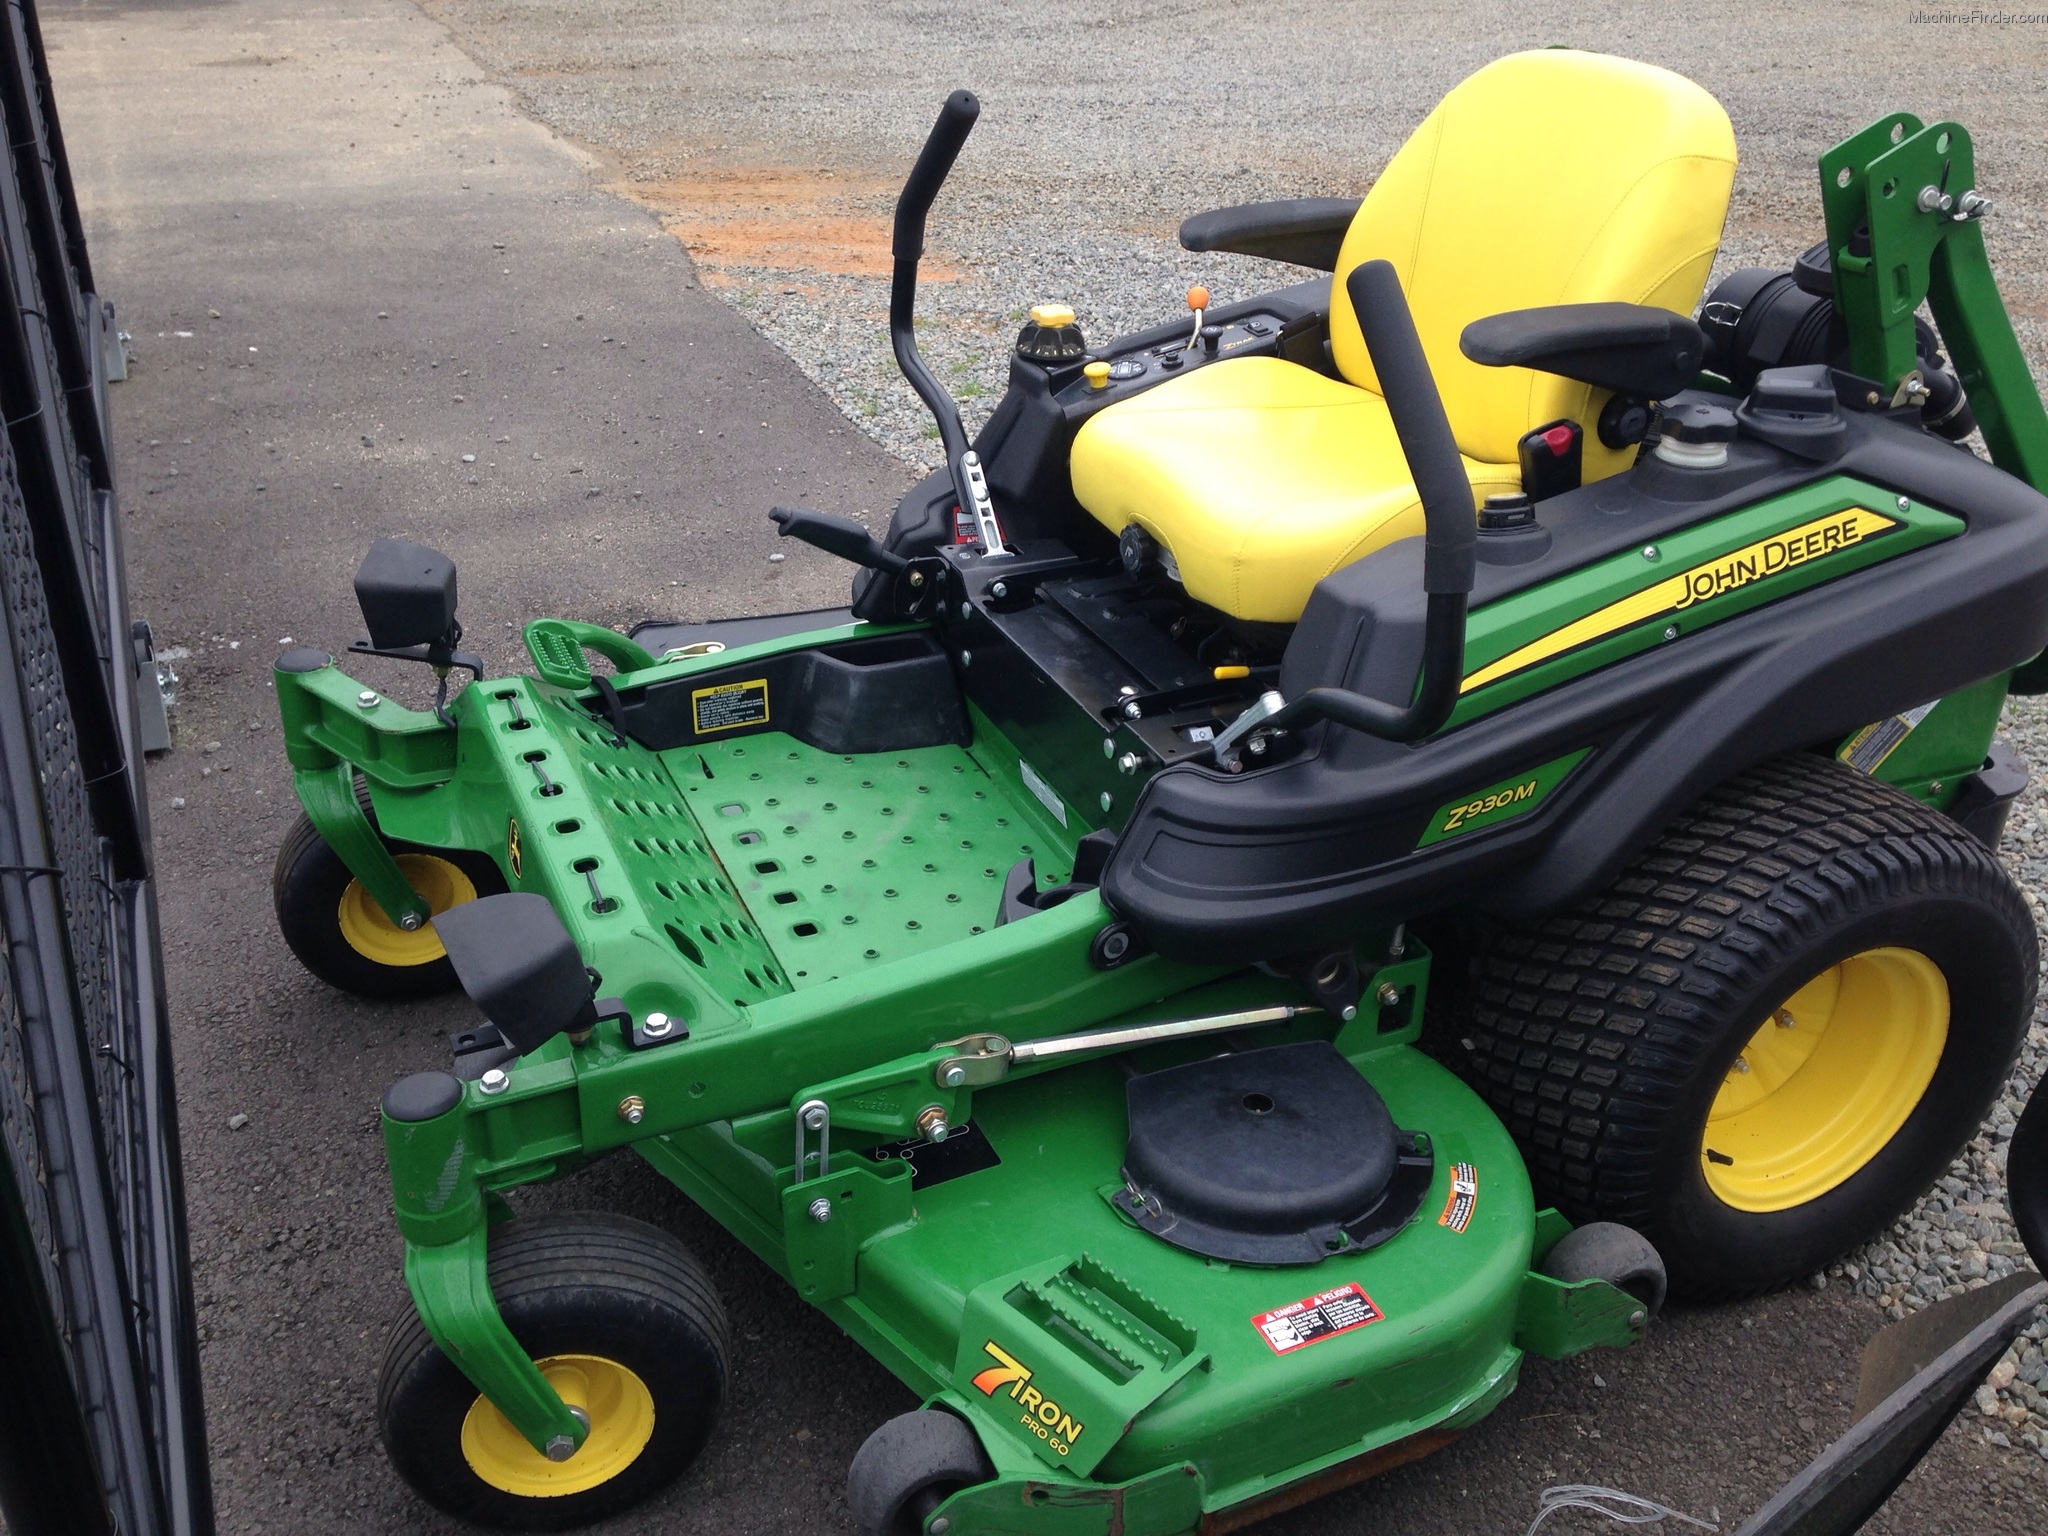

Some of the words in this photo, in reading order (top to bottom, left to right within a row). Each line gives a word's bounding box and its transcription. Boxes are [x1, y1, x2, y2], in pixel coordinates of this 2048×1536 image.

[1676, 555, 1758, 606] JOHN
[1763, 517, 1859, 571] DEERE
[1443, 780, 1537, 832] Z930M
[1273, 1303, 1305, 1318] DANGER
[1321, 1286, 1353, 1301] PELIGRO
[972, 1340, 1033, 1397] 7
[1010, 1378, 1083, 1444] IRON
[1020, 1414, 1049, 1440] PRO
[1049, 1438, 1069, 1456] 60
